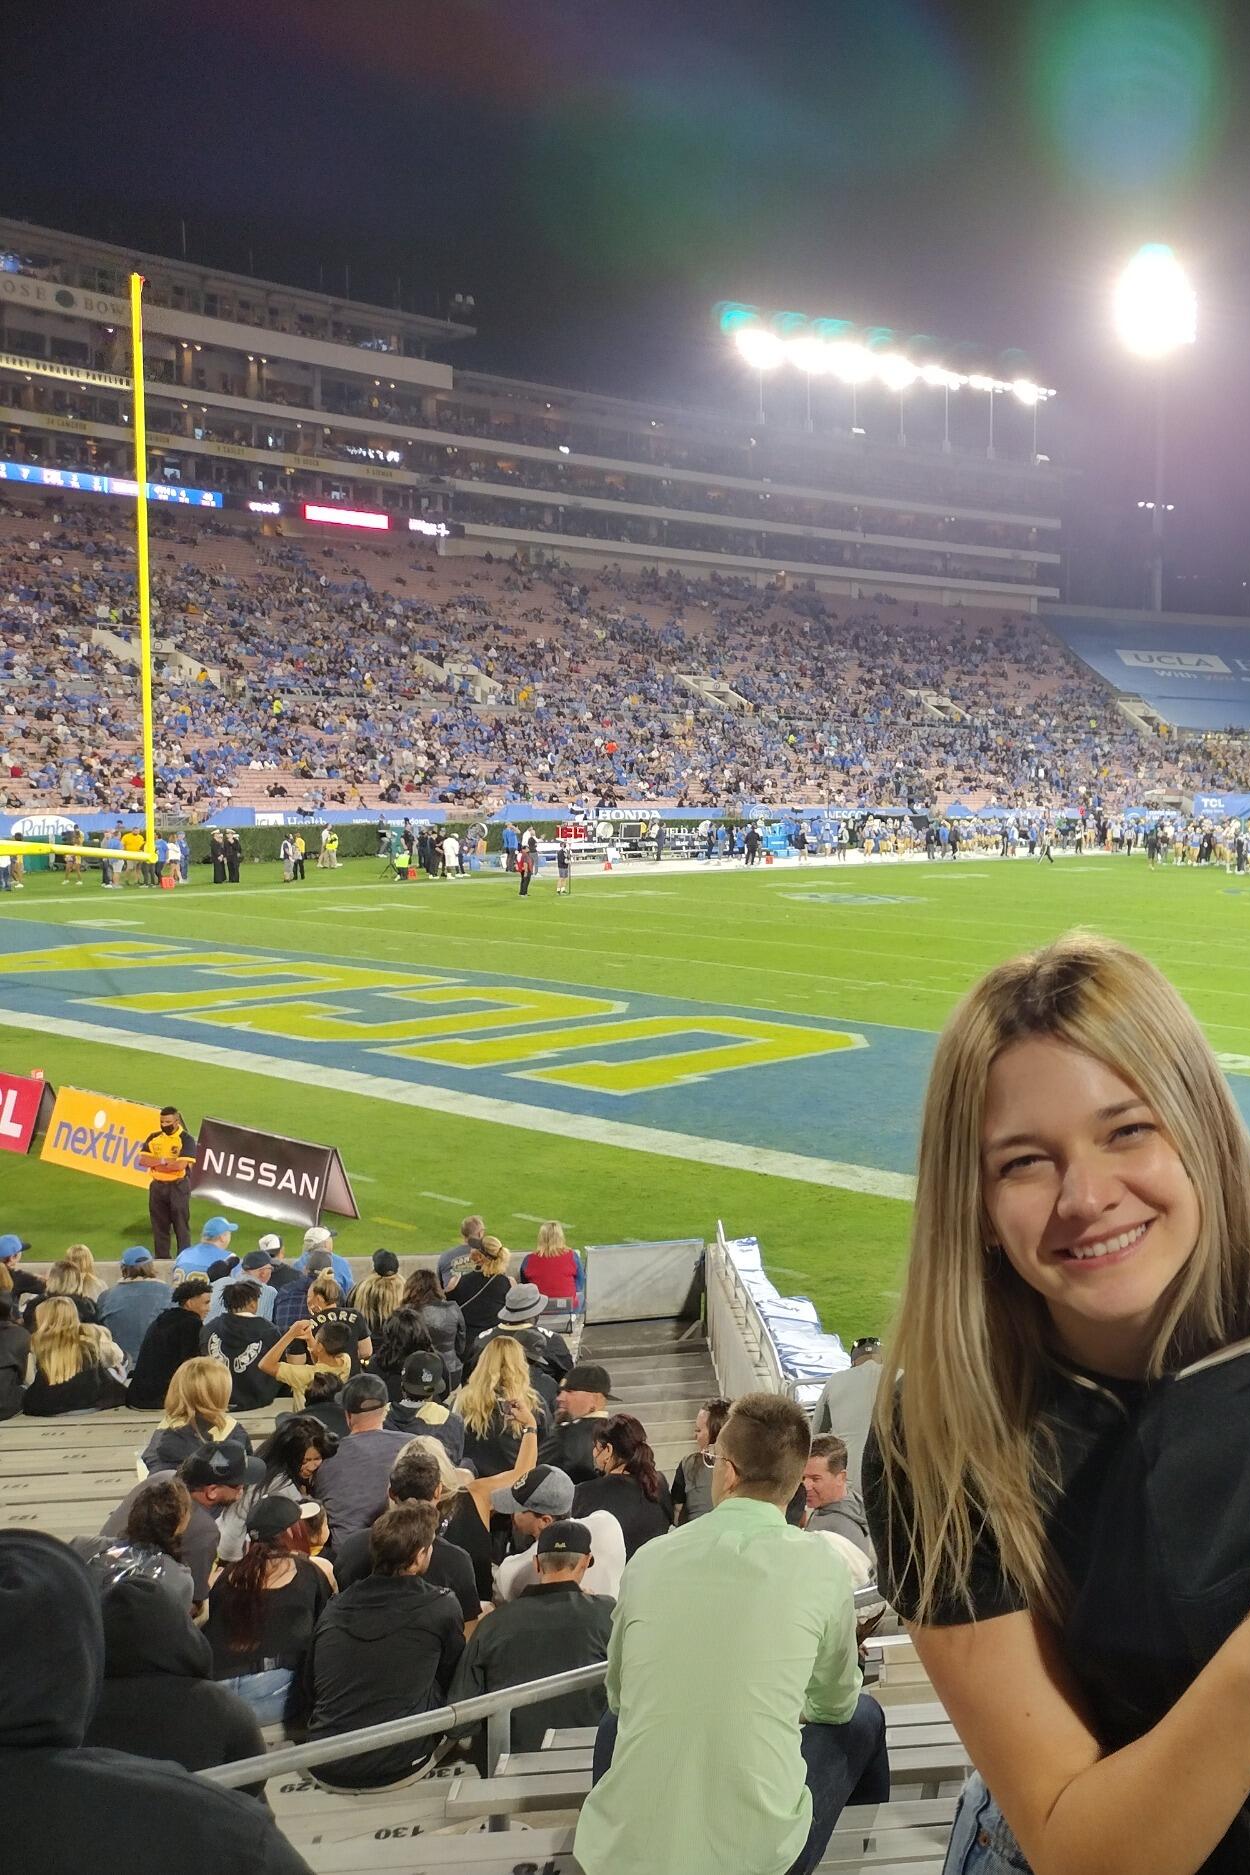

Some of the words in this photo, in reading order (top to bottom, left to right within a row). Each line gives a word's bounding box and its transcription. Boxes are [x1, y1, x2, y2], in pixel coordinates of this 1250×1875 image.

[84, 295, 127, 315] BOW
[1132, 653, 1214, 667] UCLA
[1155, 670, 1198, 679] With
[1202, 798, 1225, 808] TCL
[598, 809, 661, 820] HONDA
[824, 810, 867, 820] WESCO
[22, 818, 75, 837] Ralphs
[202, 1148, 320, 1200] NISSAN
[374, 1824, 425, 1840] 130
